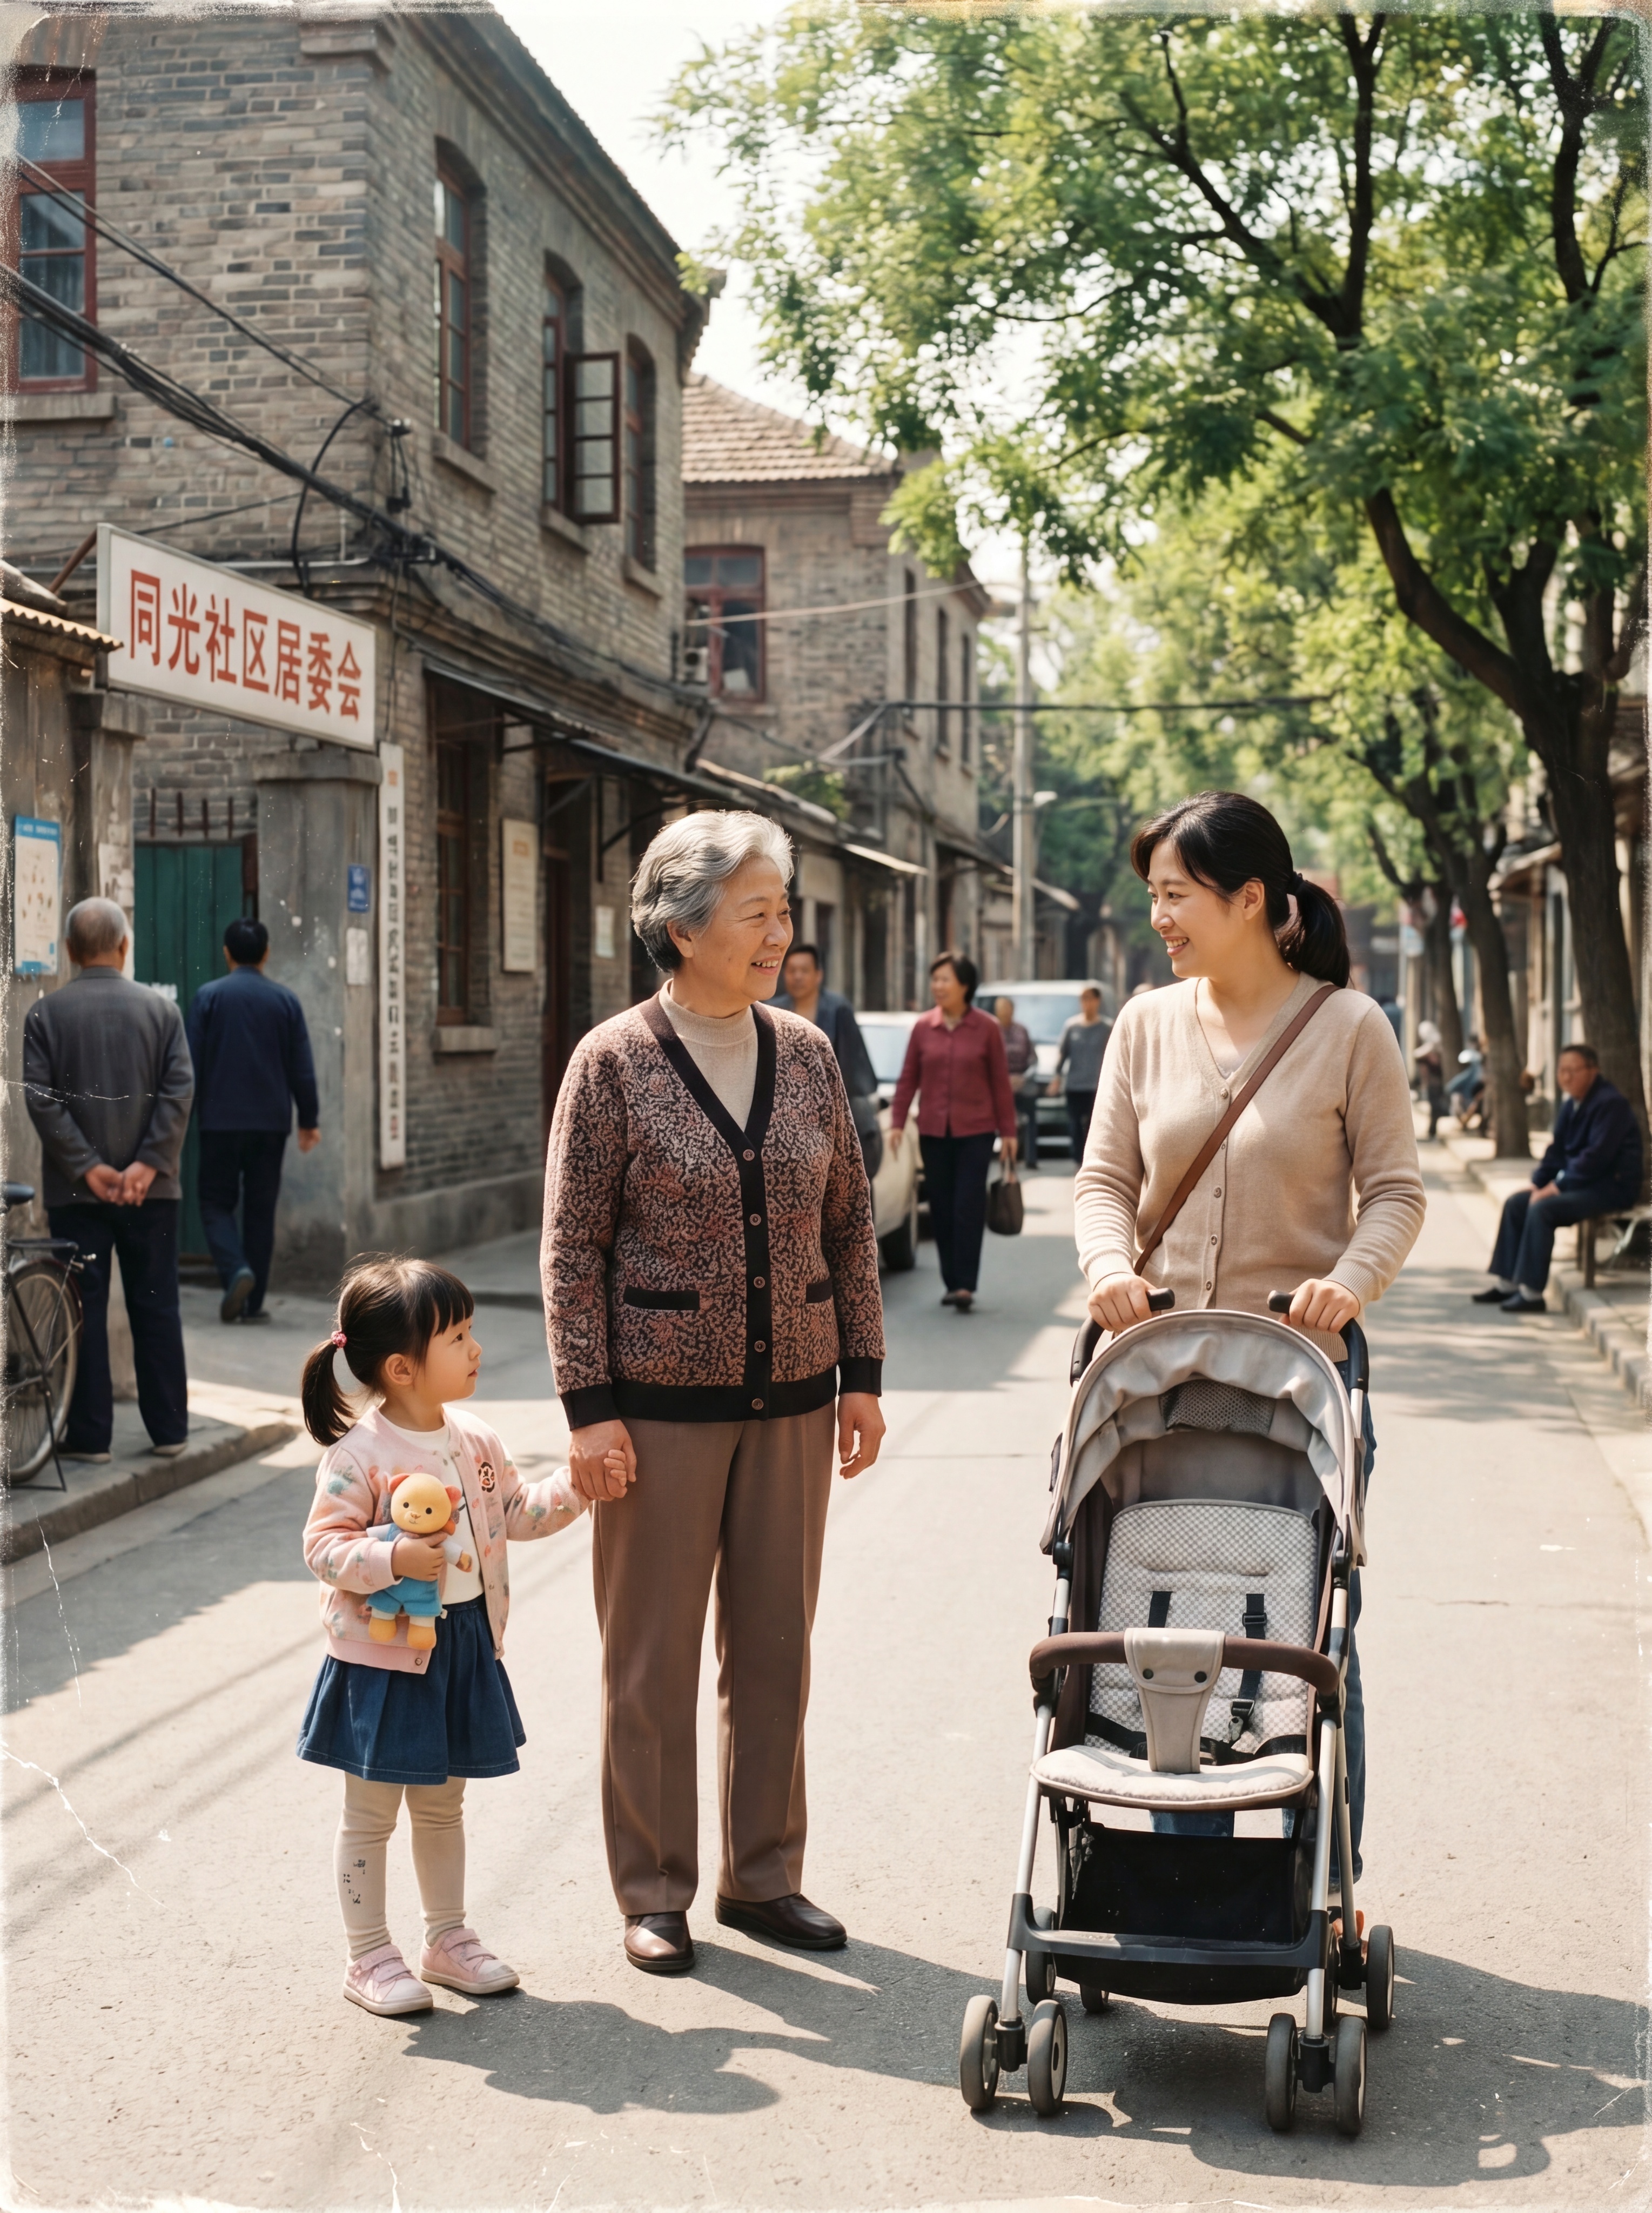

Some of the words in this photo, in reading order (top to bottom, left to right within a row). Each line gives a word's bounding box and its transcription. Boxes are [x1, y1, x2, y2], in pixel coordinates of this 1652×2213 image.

[130, 569, 362, 721] 同光社区居委会
